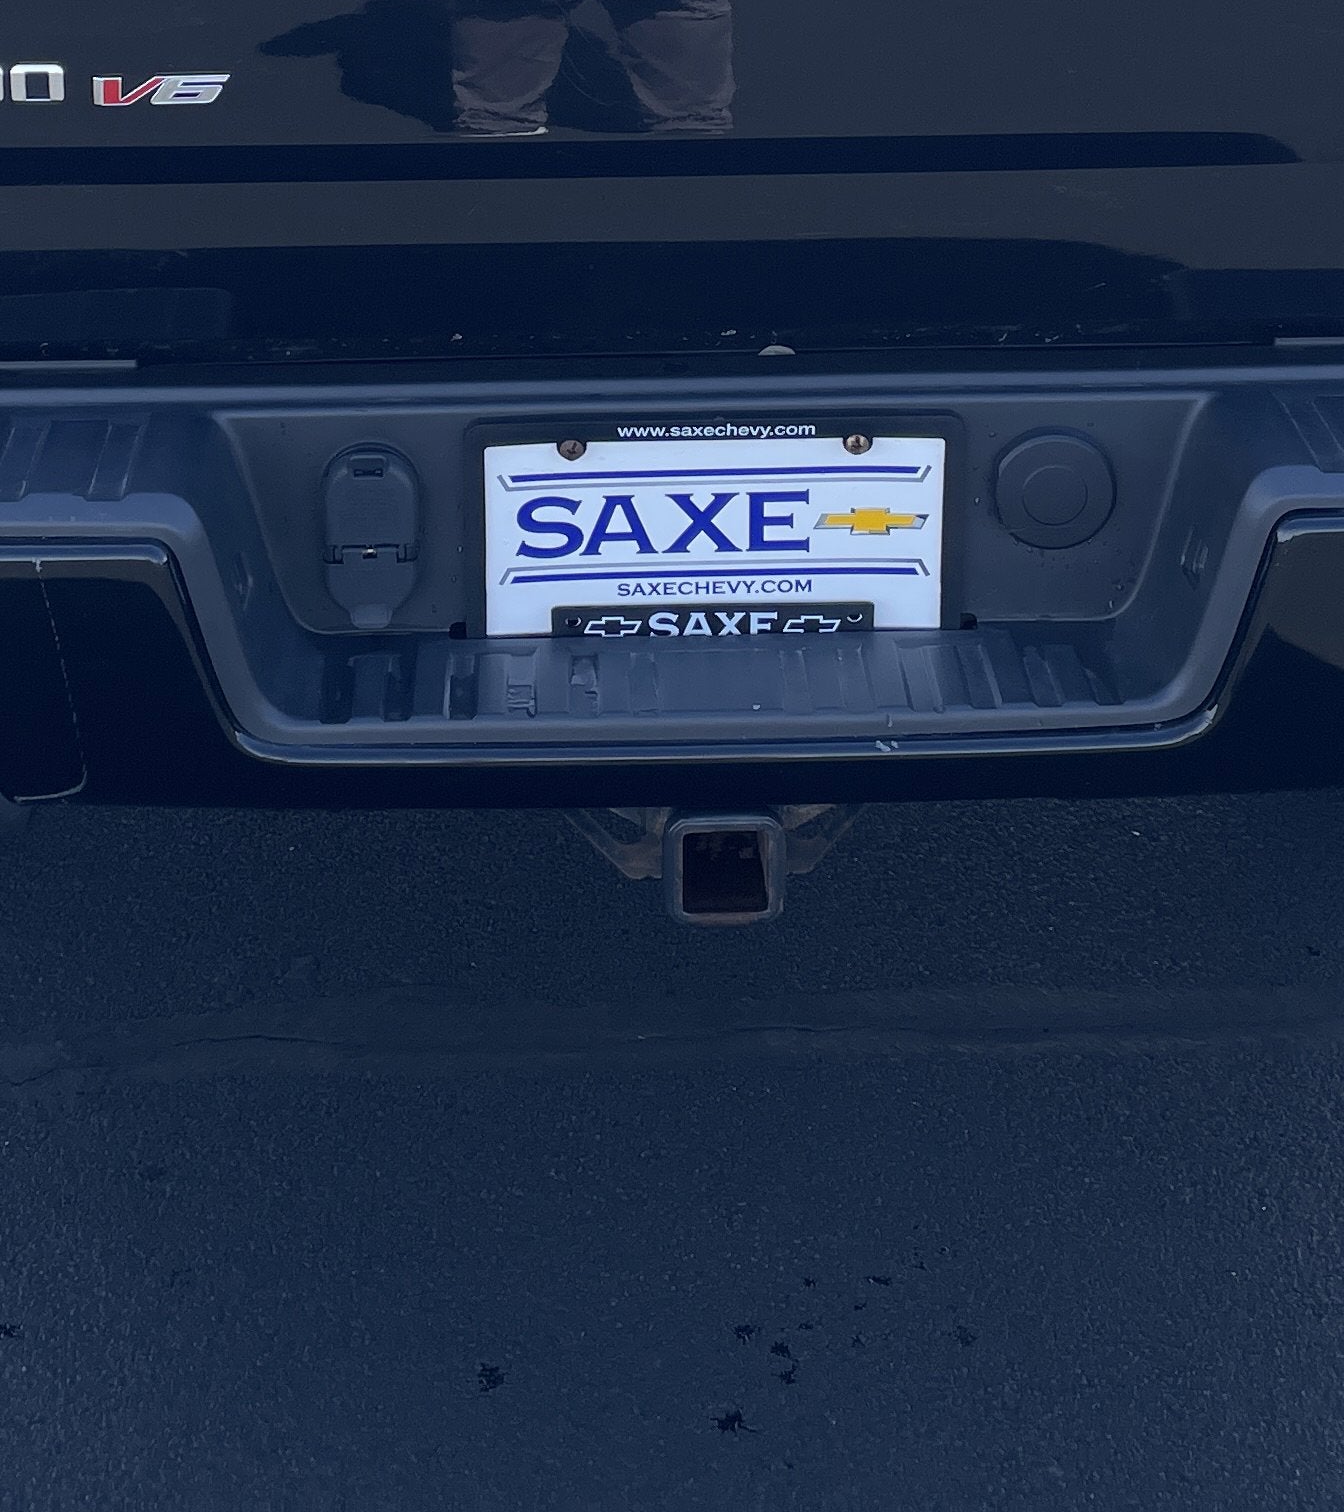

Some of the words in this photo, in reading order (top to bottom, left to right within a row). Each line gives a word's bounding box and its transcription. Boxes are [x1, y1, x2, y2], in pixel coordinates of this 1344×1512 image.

[92, 73, 232, 106] V6
[616, 423, 817, 439] www.saxechevy.com
[515, 488, 811, 558] SAXE
[616, 579, 813, 597] SAXECHEVY.COM
[647, 610, 778, 638] SAXE
